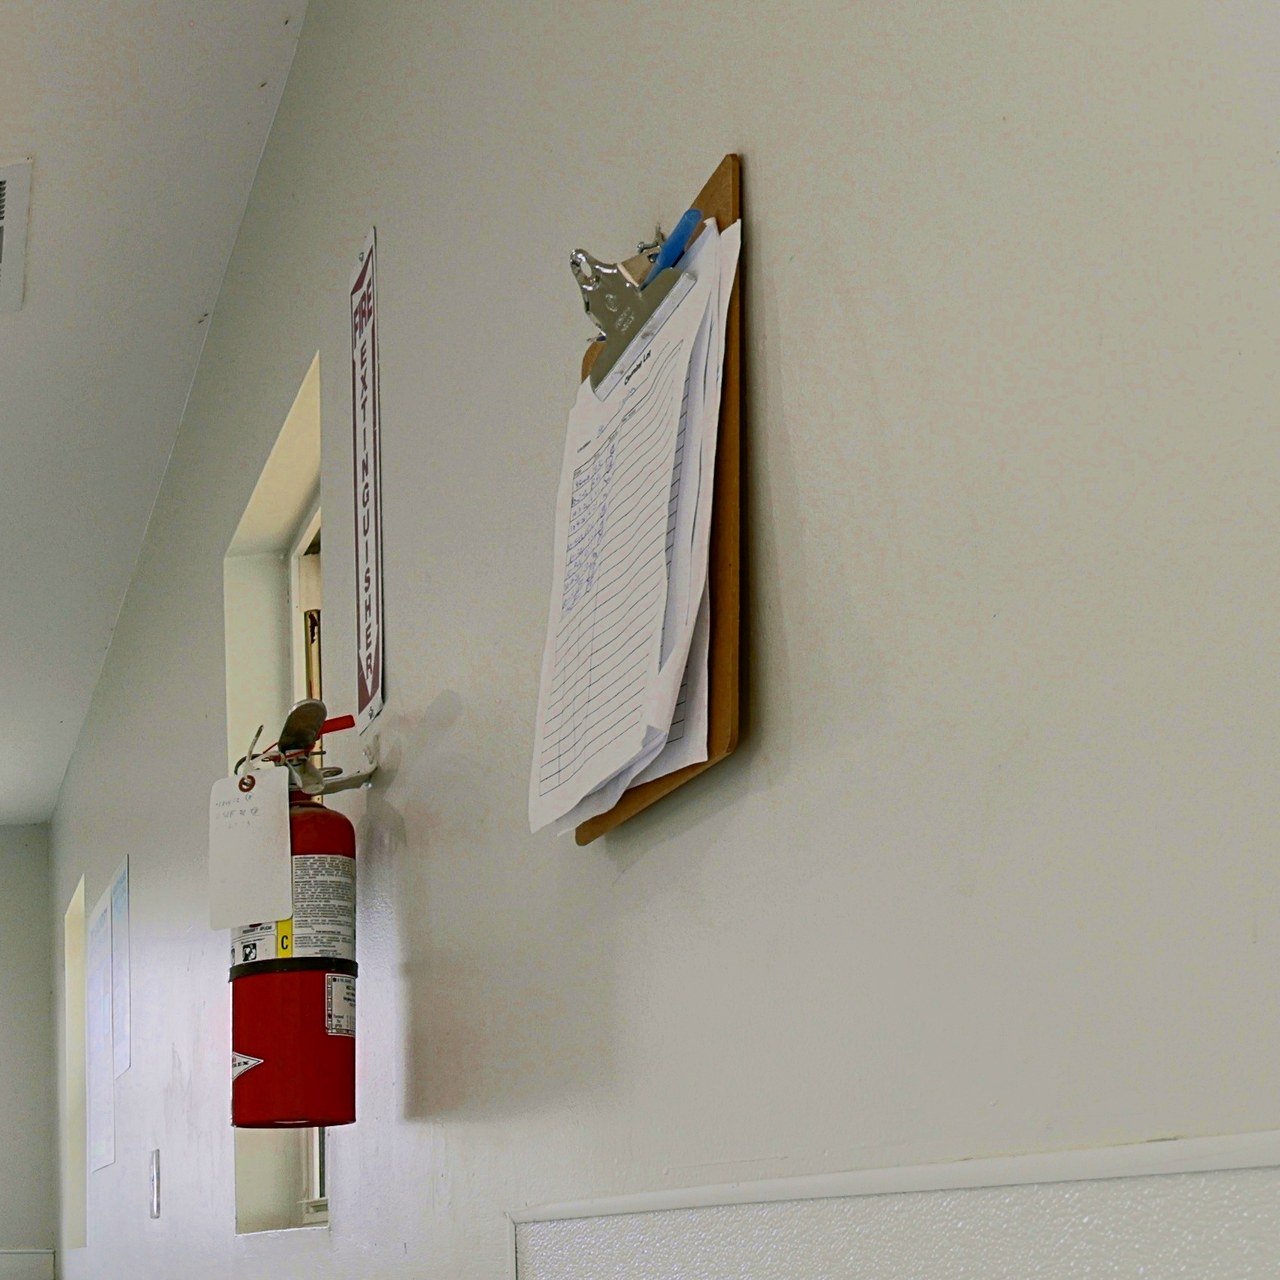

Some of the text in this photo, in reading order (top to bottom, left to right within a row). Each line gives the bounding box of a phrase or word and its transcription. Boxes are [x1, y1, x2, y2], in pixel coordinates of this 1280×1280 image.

[354, 277, 373, 349] FIRE
[360, 339, 373, 680] EXTINGUISHER
[281, 935, 289, 950] C
